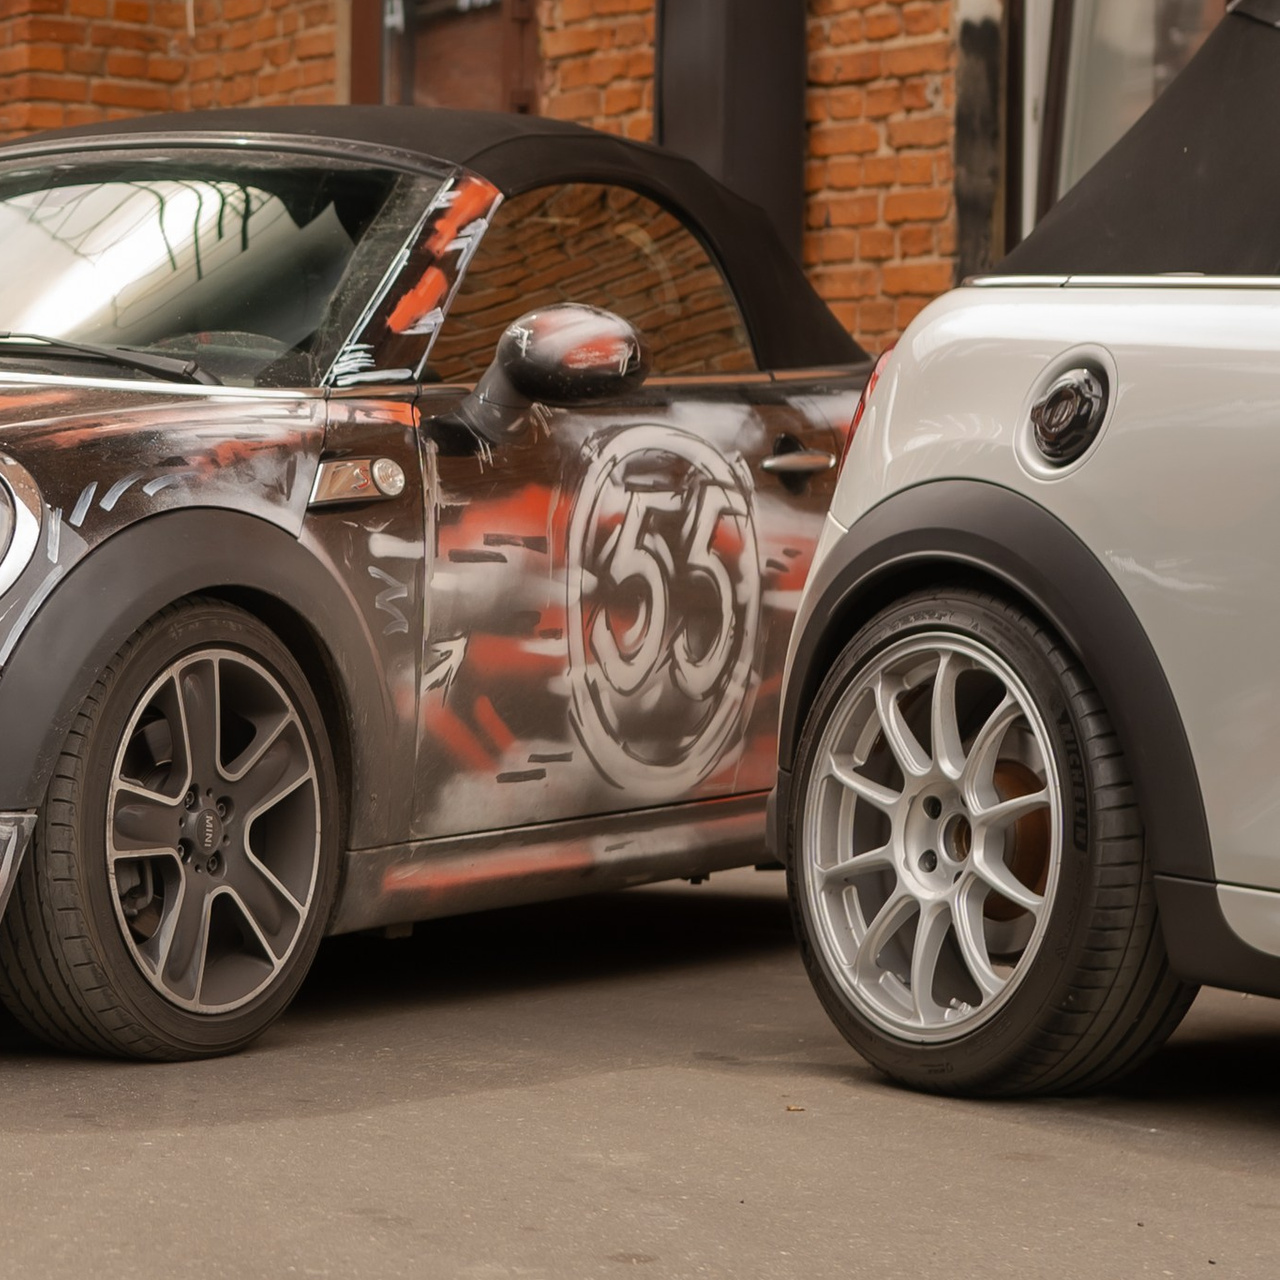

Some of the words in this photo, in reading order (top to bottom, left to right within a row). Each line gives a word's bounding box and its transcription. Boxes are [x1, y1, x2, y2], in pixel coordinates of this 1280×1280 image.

[590, 479, 751, 702] 55
[205, 815, 214, 847] MINI
[1060, 722, 1087, 845] MICHELIN
